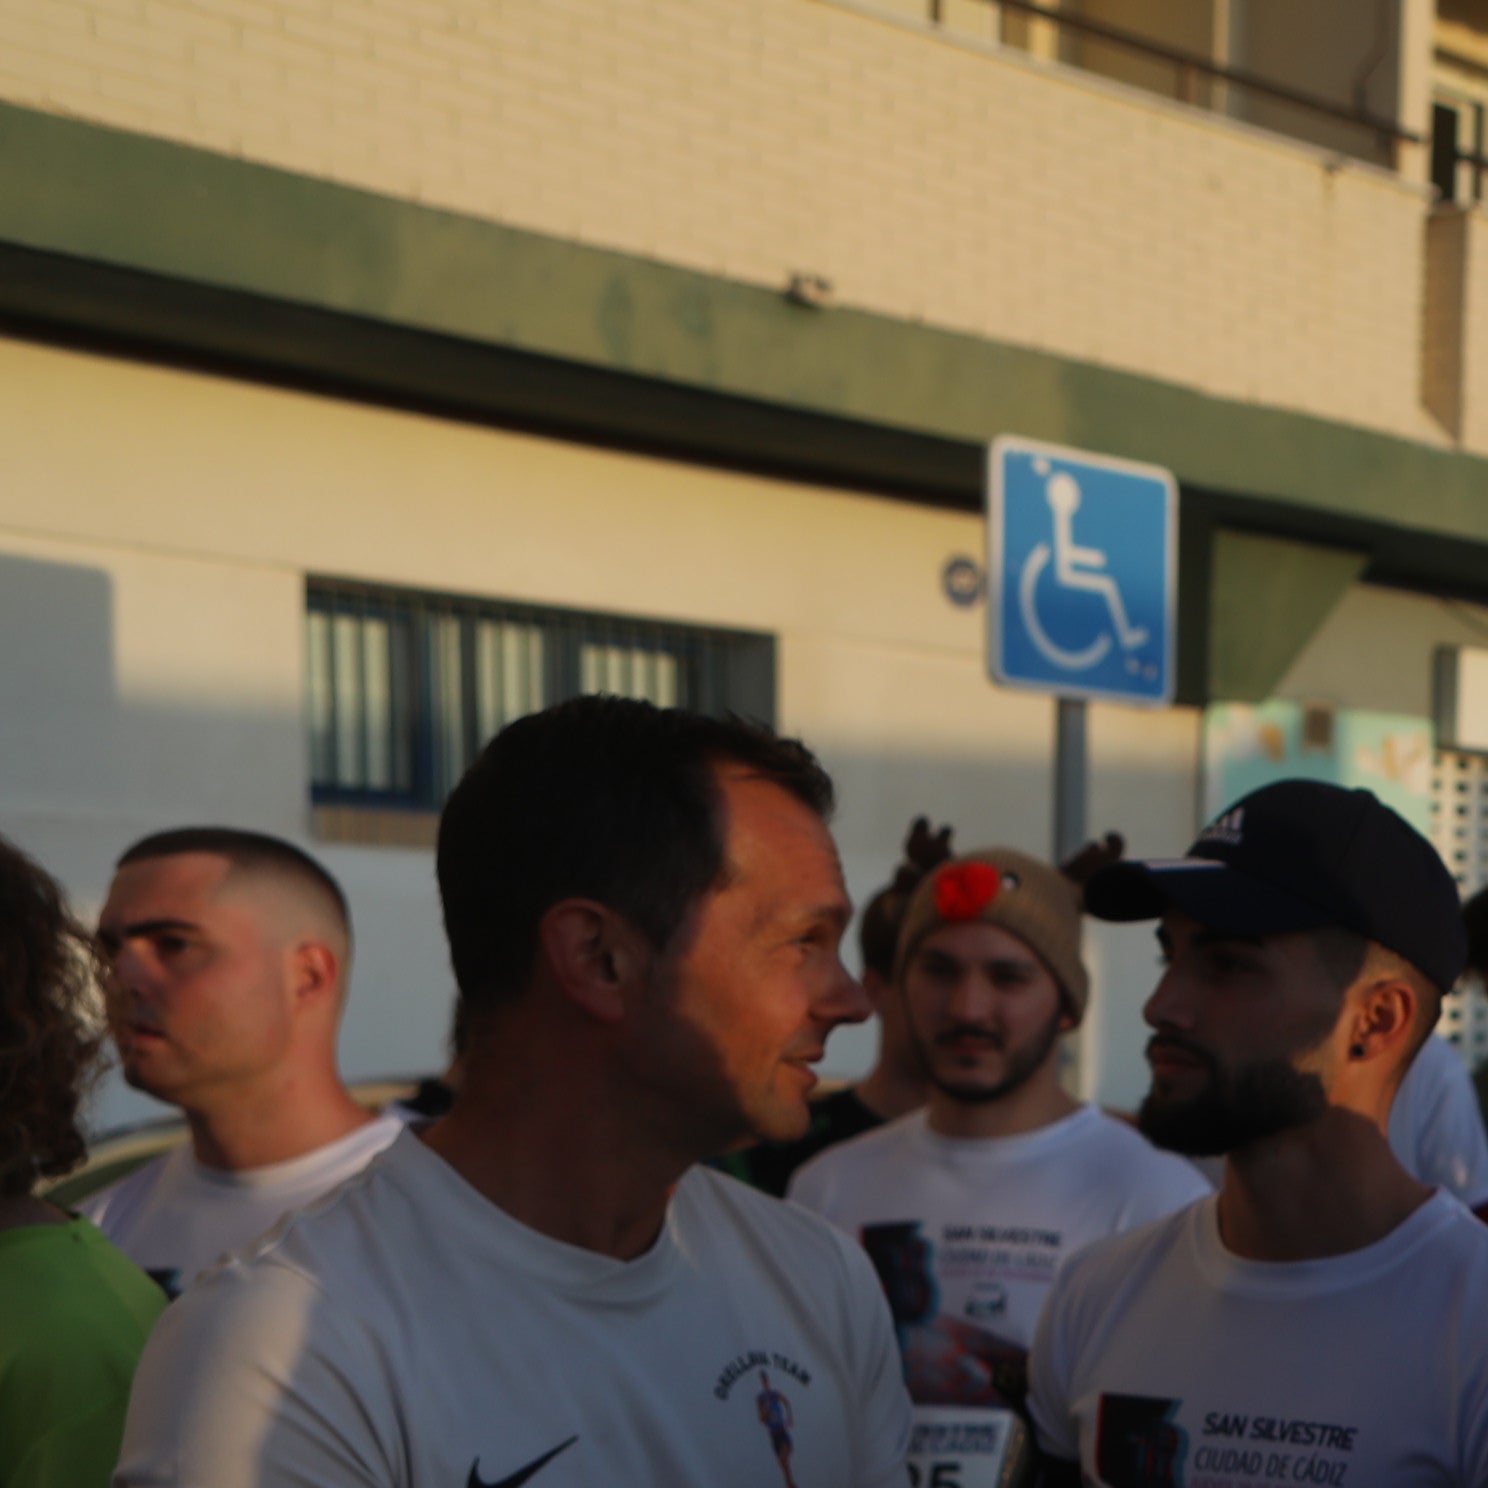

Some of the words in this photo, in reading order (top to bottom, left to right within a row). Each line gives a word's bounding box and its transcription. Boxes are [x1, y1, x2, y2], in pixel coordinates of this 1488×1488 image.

[1202, 1412, 1248, 1437] SAN
[1249, 1416, 1359, 1452] SILVESTRE
[1194, 1447, 1263, 1476] CIUDAD
[1265, 1453, 1292, 1479] DE
